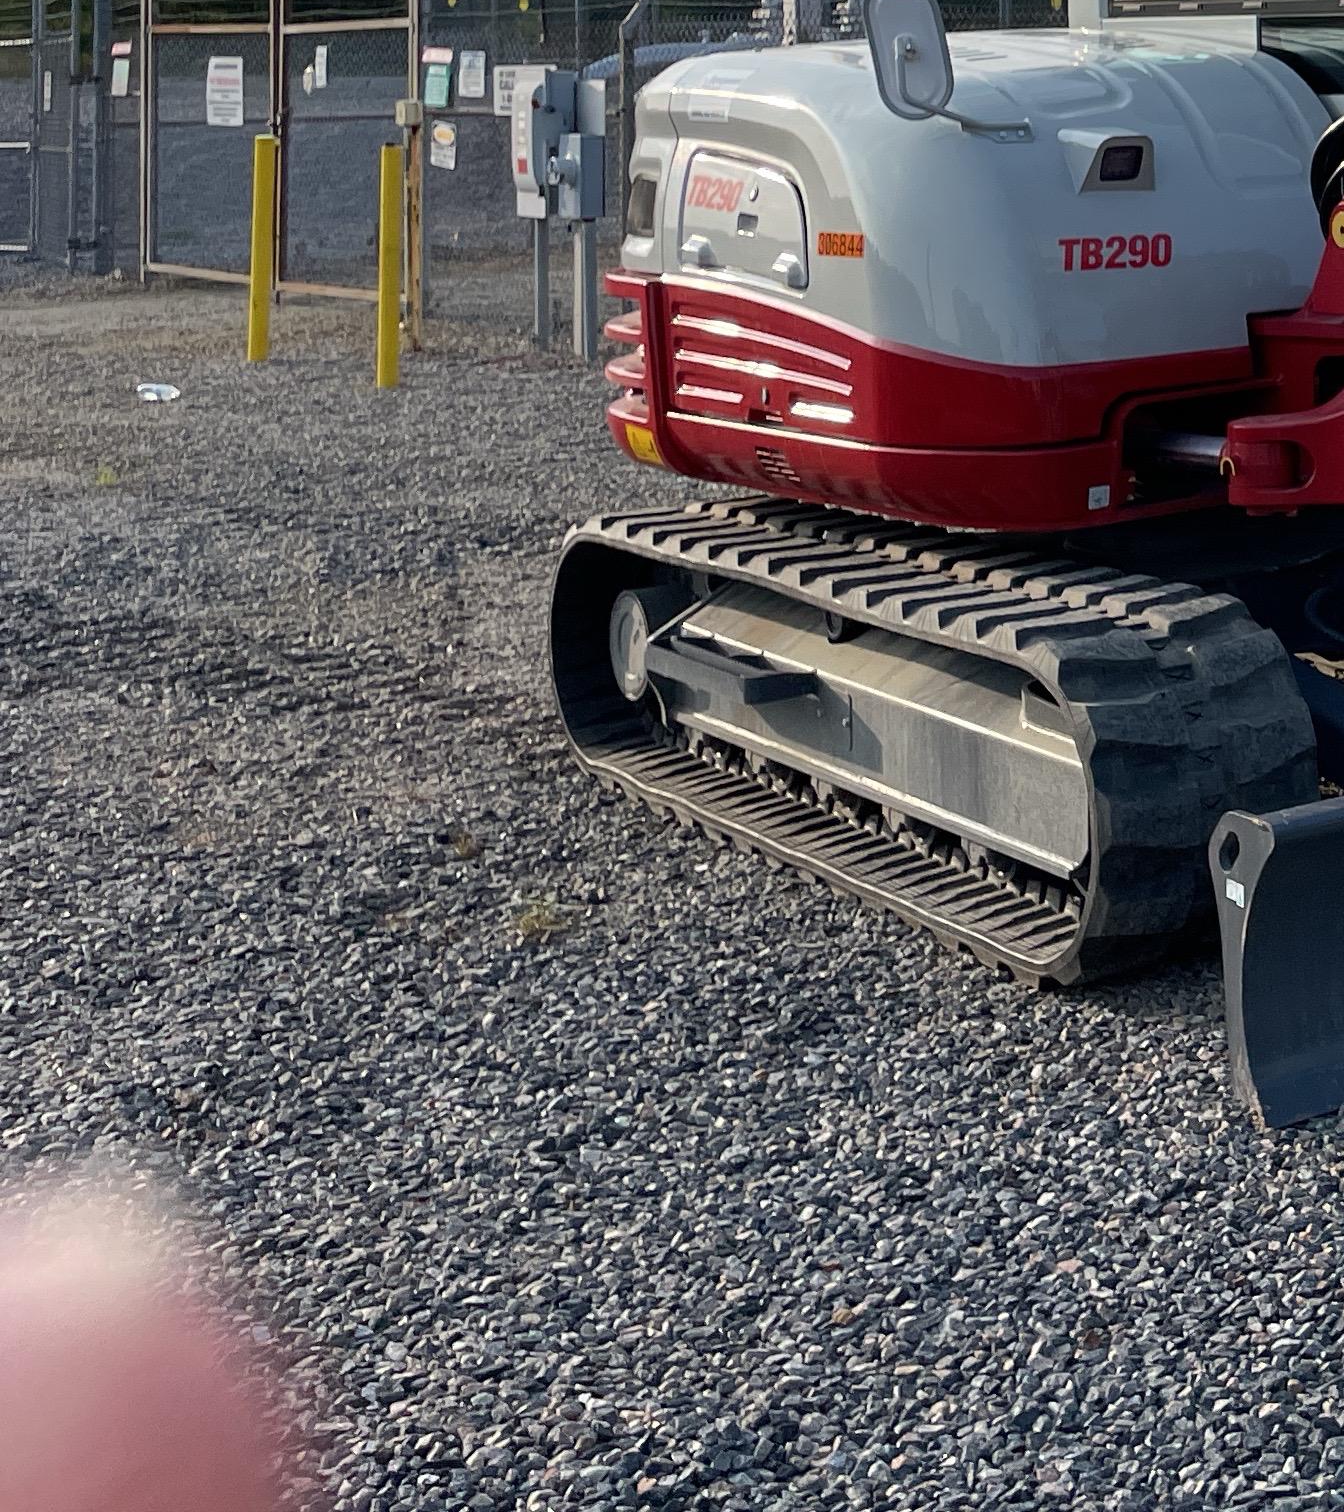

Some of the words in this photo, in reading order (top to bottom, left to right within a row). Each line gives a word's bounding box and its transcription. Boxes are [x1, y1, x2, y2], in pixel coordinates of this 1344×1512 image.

[688, 175, 743, 213] TB290
[818, 233, 864, 257] 306844
[1058, 233, 1172, 272] TB290
